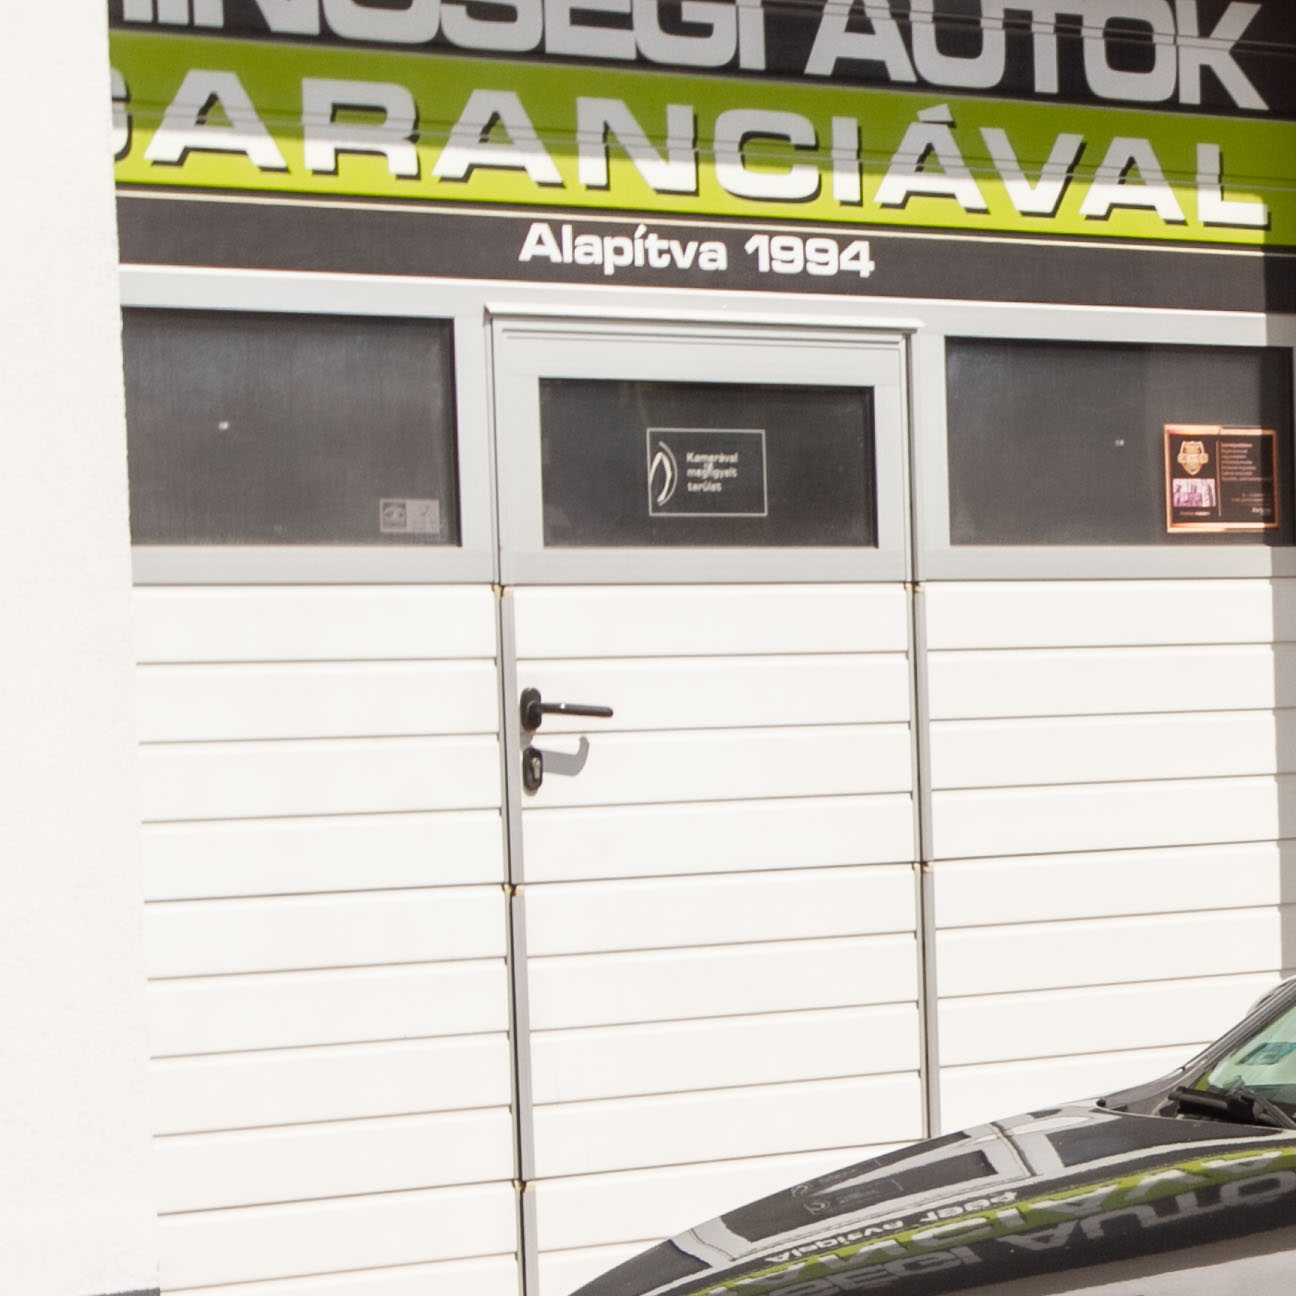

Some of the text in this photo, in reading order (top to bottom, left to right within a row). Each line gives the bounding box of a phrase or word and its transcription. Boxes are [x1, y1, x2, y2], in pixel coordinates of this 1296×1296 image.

[111, 66, 1271, 231] ARANCIÁVAL
[518, 221, 876, 279] Alapítva 1994
